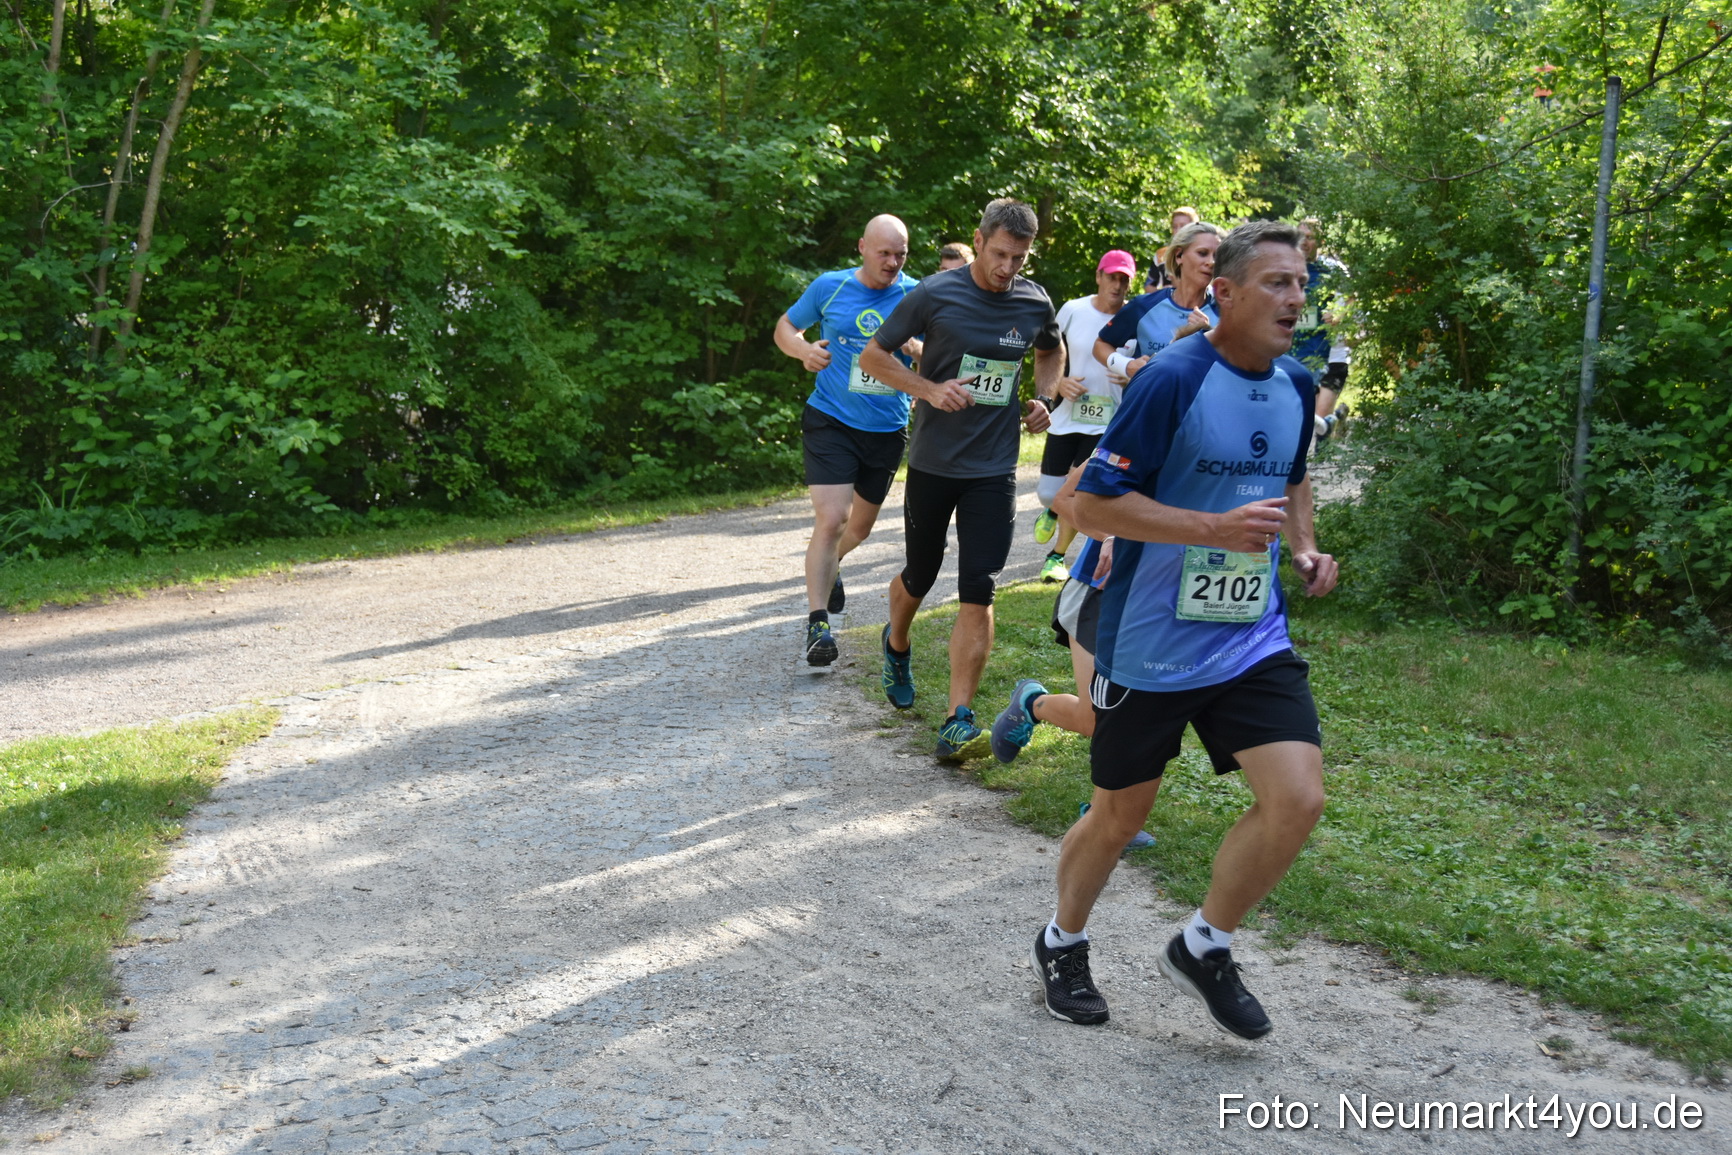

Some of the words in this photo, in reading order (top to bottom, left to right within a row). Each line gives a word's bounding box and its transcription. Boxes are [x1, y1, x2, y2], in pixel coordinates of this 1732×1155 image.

[968, 374, 1003, 393] 418
[1080, 404, 1104, 417] 962
[1195, 458, 1297, 477] SCHABMÜLLE
[1236, 484, 1265, 497] TEAM
[1191, 574, 1262, 602] 2102
[1203, 601, 1226, 610] Baierl
[1226, 602, 1250, 611] Jürgen
